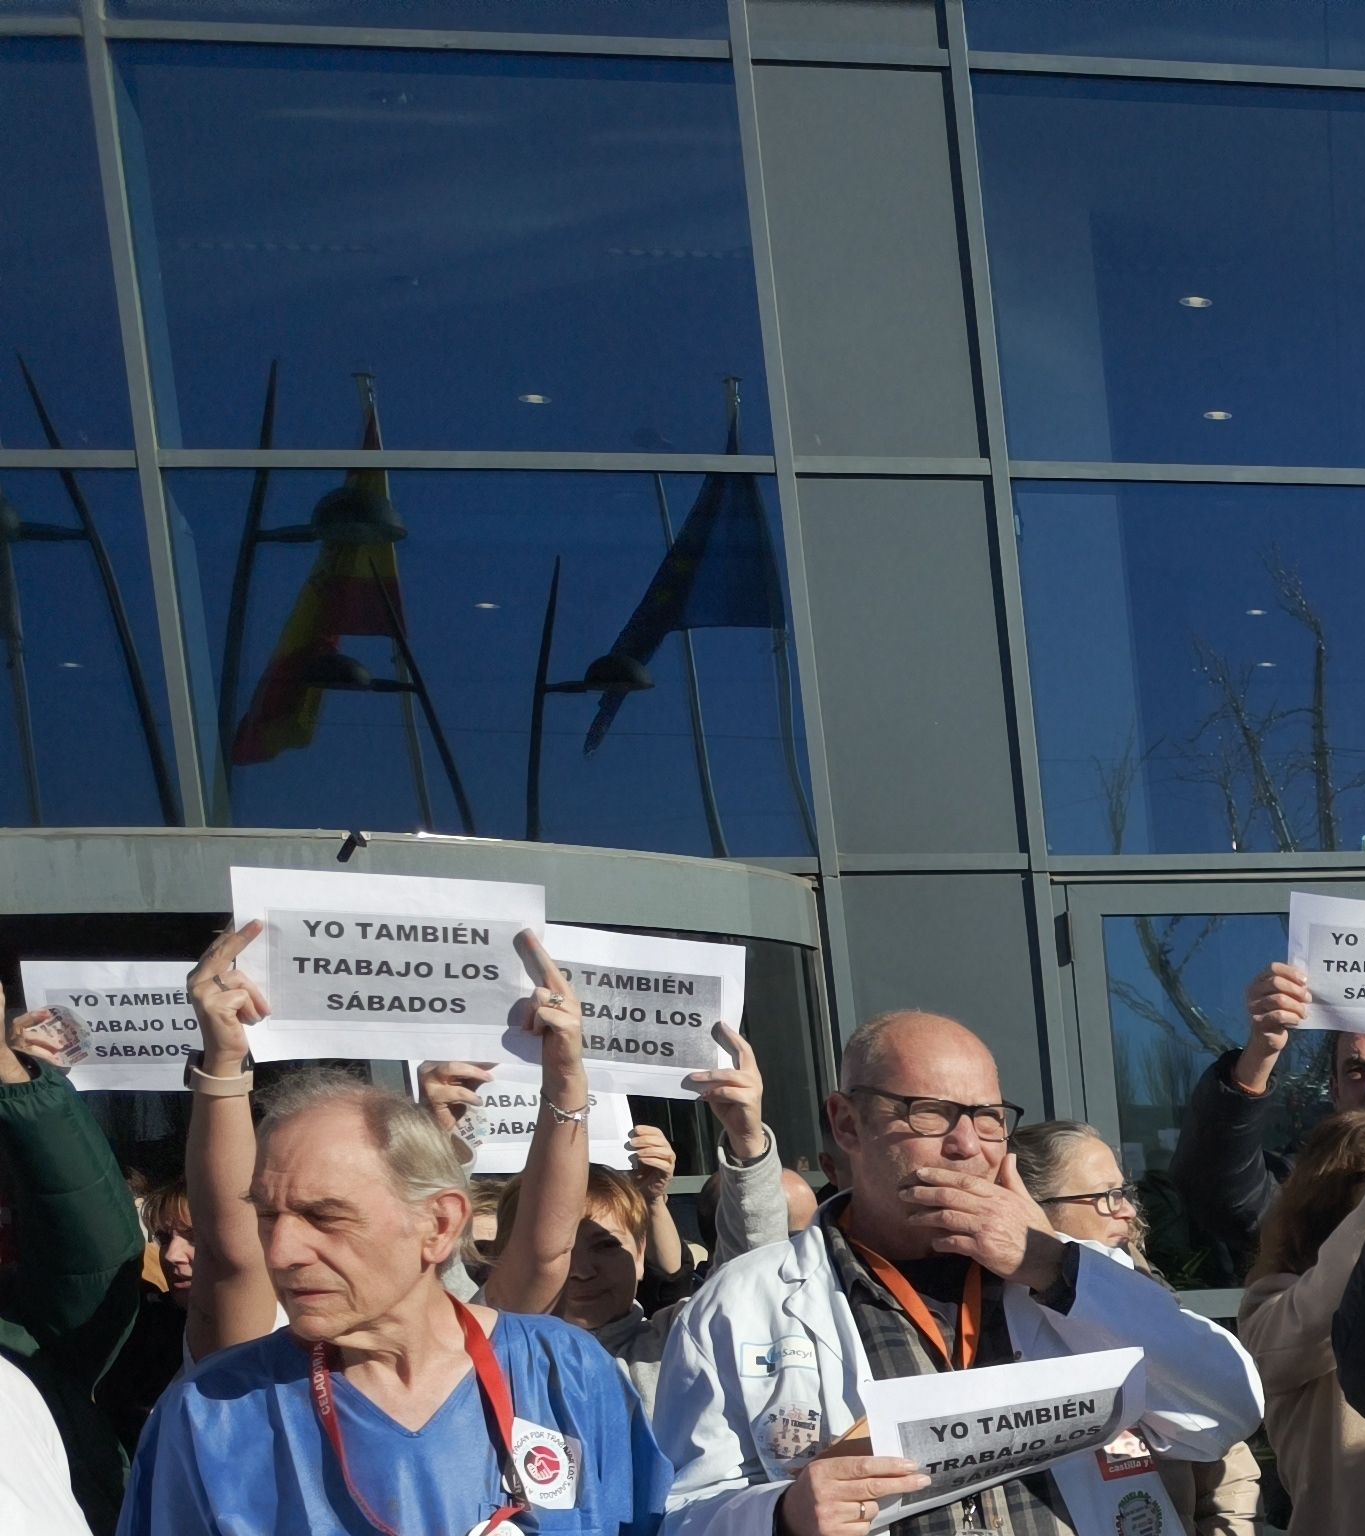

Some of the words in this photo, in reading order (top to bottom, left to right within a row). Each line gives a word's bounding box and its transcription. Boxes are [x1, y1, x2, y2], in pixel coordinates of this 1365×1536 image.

[302, 918, 345, 940] YO
[354, 919, 490, 947] TAMBIÉN
[1330, 932, 1359, 949] YO
[293, 956, 433, 980] TRABAJO
[443, 961, 500, 983] LOS
[557, 967, 573, 982] O
[581, 969, 694, 996] TAMBIÉN
[69, 994, 98, 1007] YO
[105, 989, 192, 1006] TAMBIÉ
[326, 988, 467, 1015] SÁBADOS
[87, 1018, 164, 1033] RABAJO
[172, 1018, 198, 1031] LO
[581, 1001, 646, 1023] BAJO
[655, 1009, 703, 1028] LOS
[581, 1033, 675, 1057] BADOS
[930, 1421, 969, 1442] YO
[977, 1399, 1096, 1435] TAMBIÉN
[926, 1438, 1047, 1475] TRABAJO
[1054, 1424, 1103, 1445] LOS
